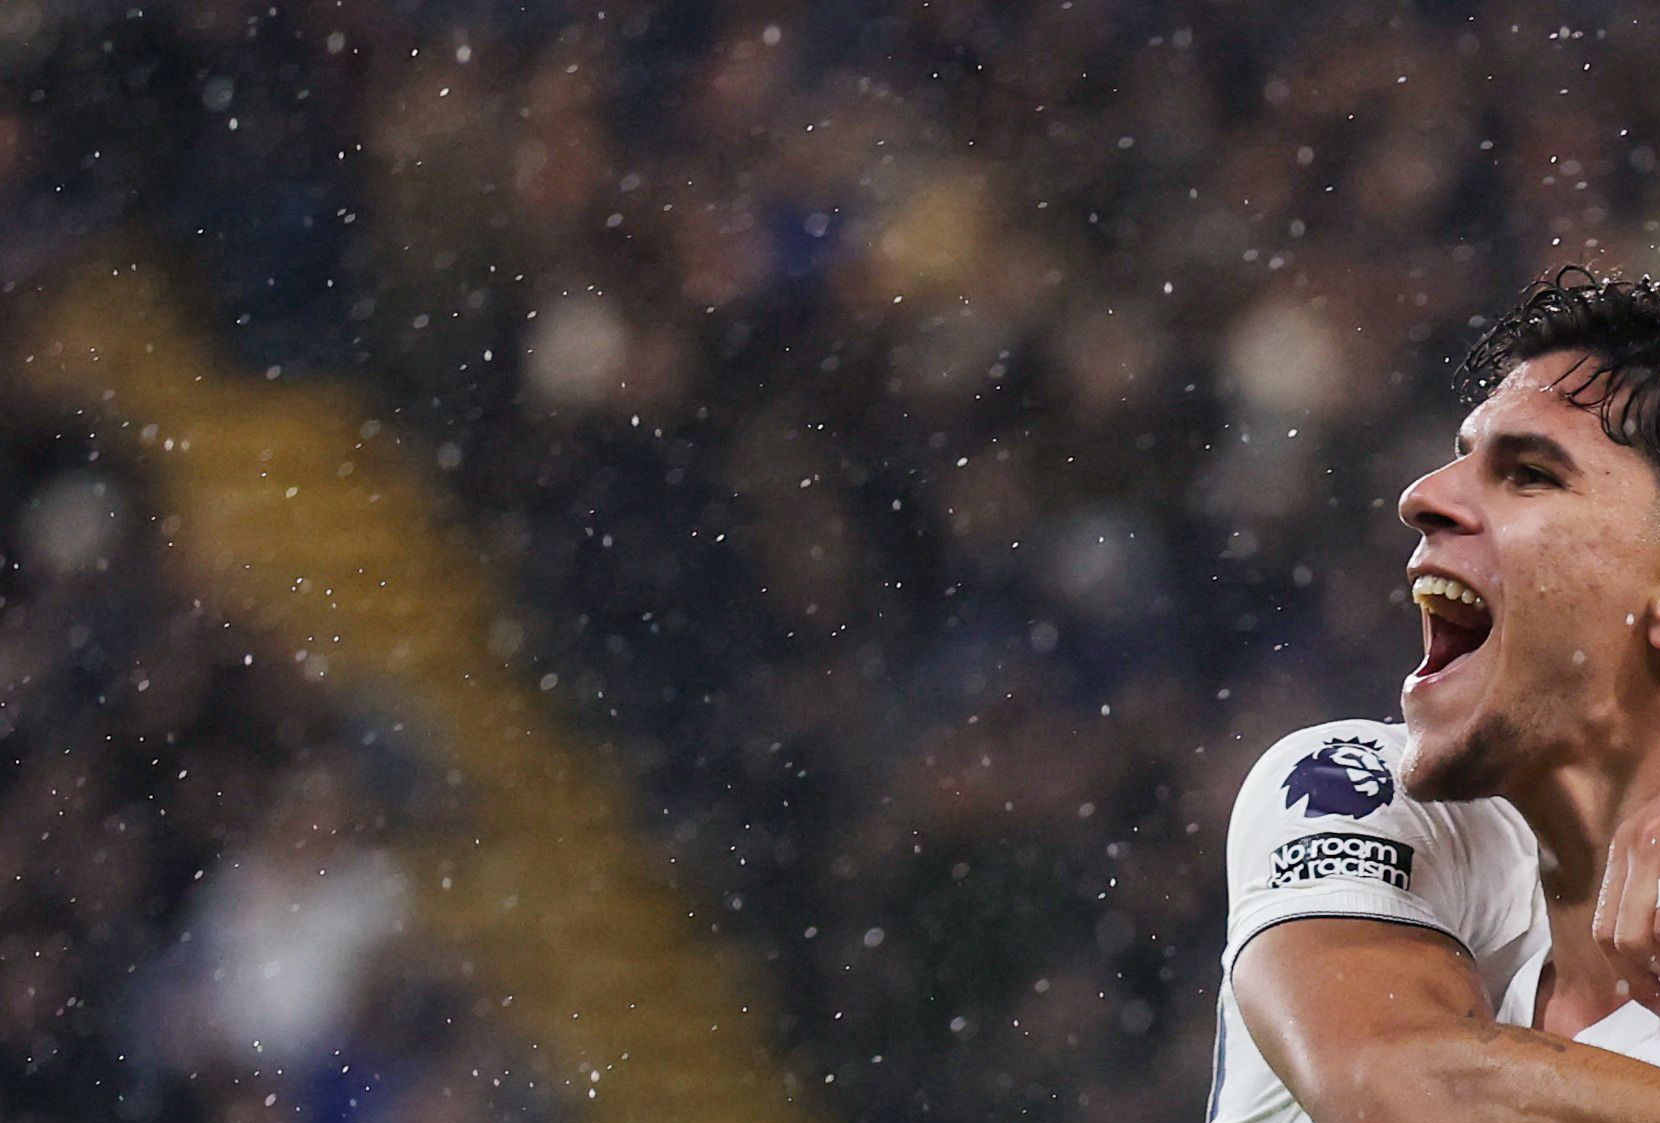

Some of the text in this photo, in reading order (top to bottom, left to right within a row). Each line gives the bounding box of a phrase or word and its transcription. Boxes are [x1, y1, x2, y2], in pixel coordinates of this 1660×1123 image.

[1270, 837, 1398, 876] No room
[1308, 857, 1409, 891] racism
